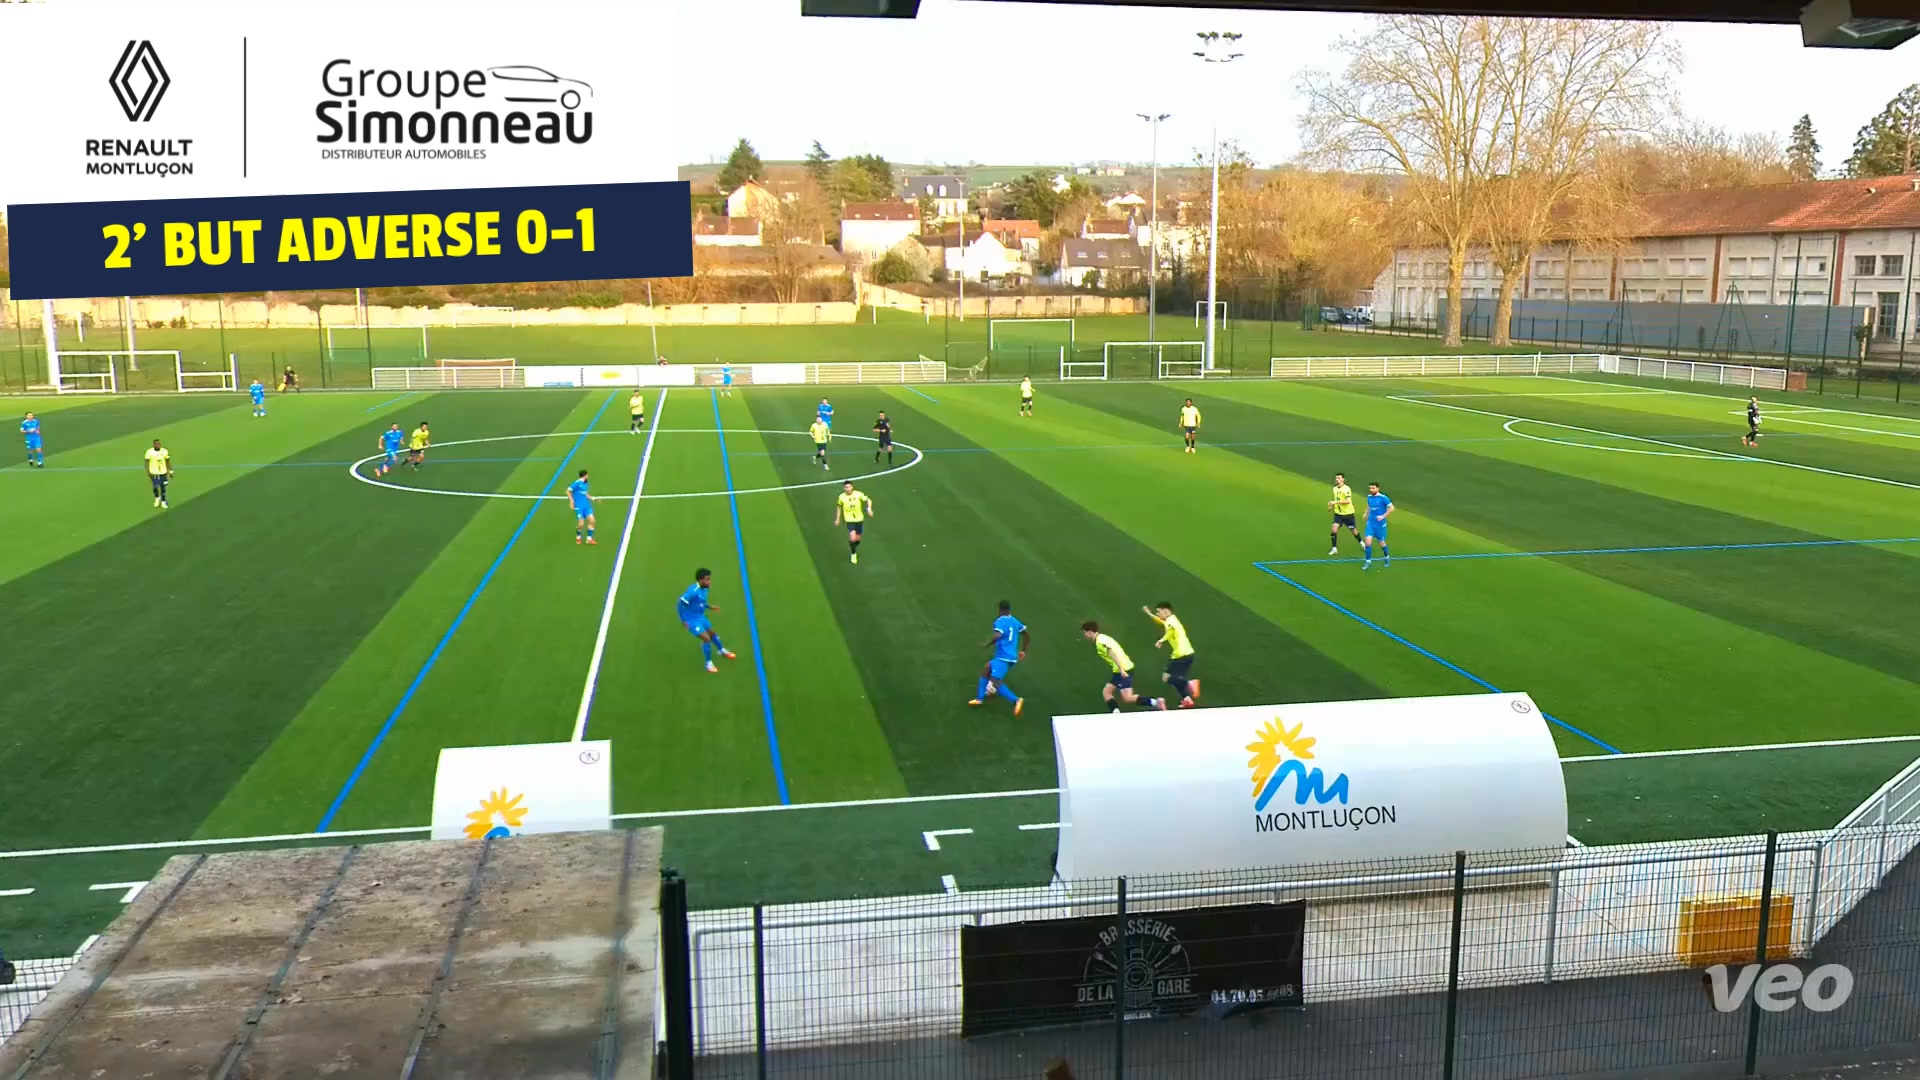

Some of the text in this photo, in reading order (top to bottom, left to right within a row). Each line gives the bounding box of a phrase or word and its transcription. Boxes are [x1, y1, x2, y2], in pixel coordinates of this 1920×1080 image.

[1255, 805, 1396, 833] MONTLUÇON
[1077, 978, 1191, 1002] DE LA GARE
